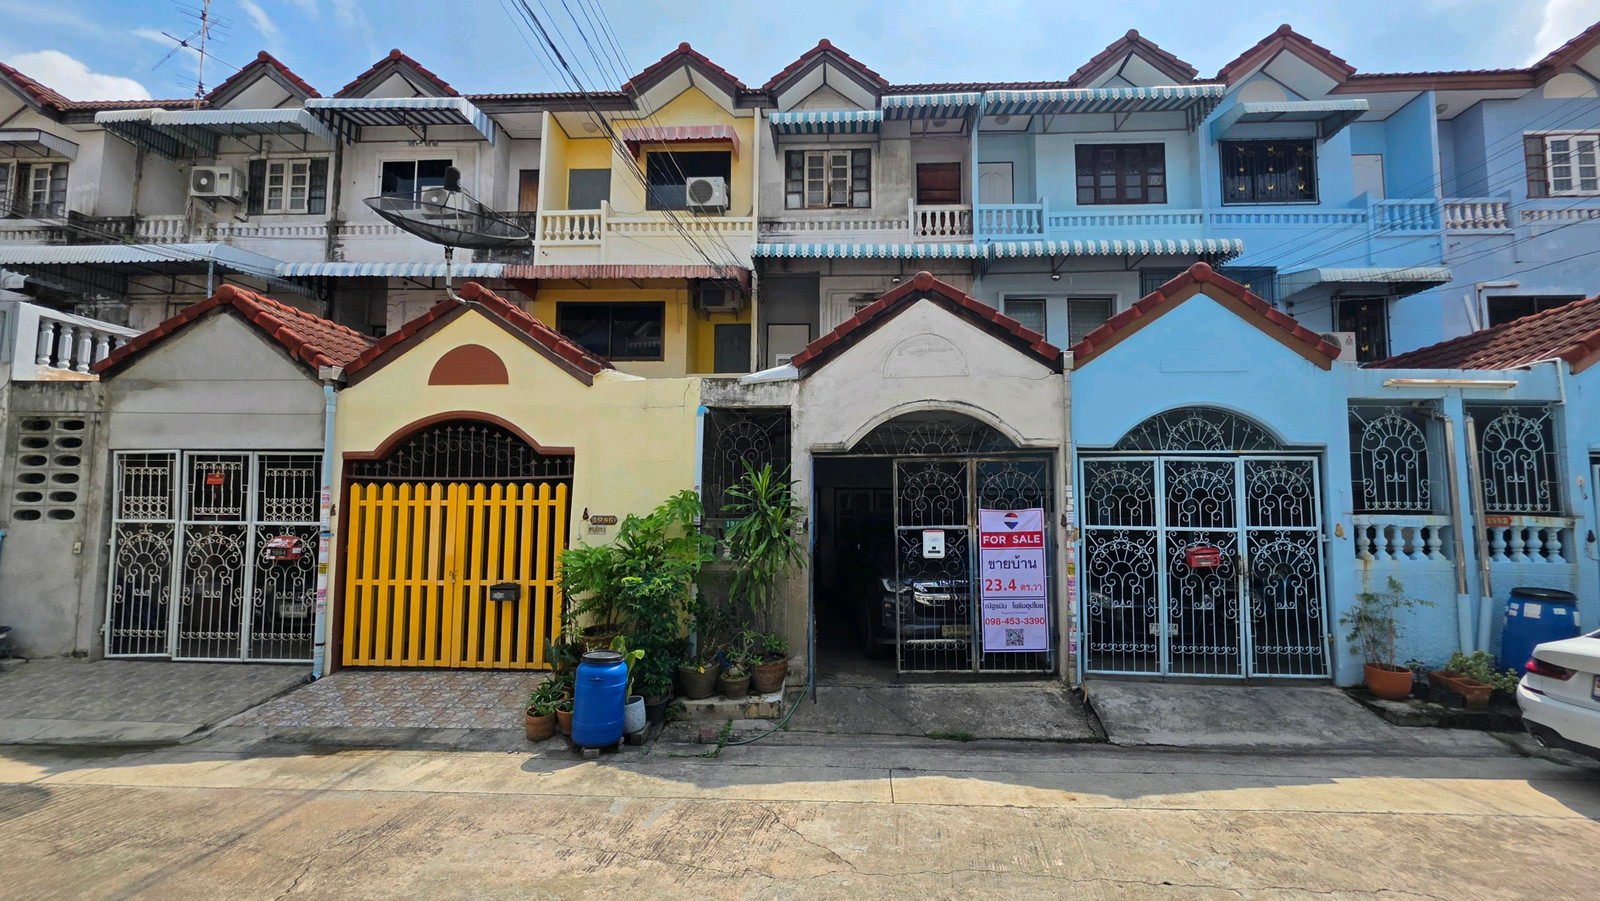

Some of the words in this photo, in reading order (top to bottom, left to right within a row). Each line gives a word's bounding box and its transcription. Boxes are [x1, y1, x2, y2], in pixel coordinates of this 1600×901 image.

[983, 535, 1006, 544] FOR
[1012, 535, 1041, 543] SALE
[988, 555, 1037, 569] ขายบ้าน
[985, 578, 1016, 591] 23.4
[1020, 583, 1042, 591] ตร.วา
[985, 617, 1045, 625] 098-453-3390
